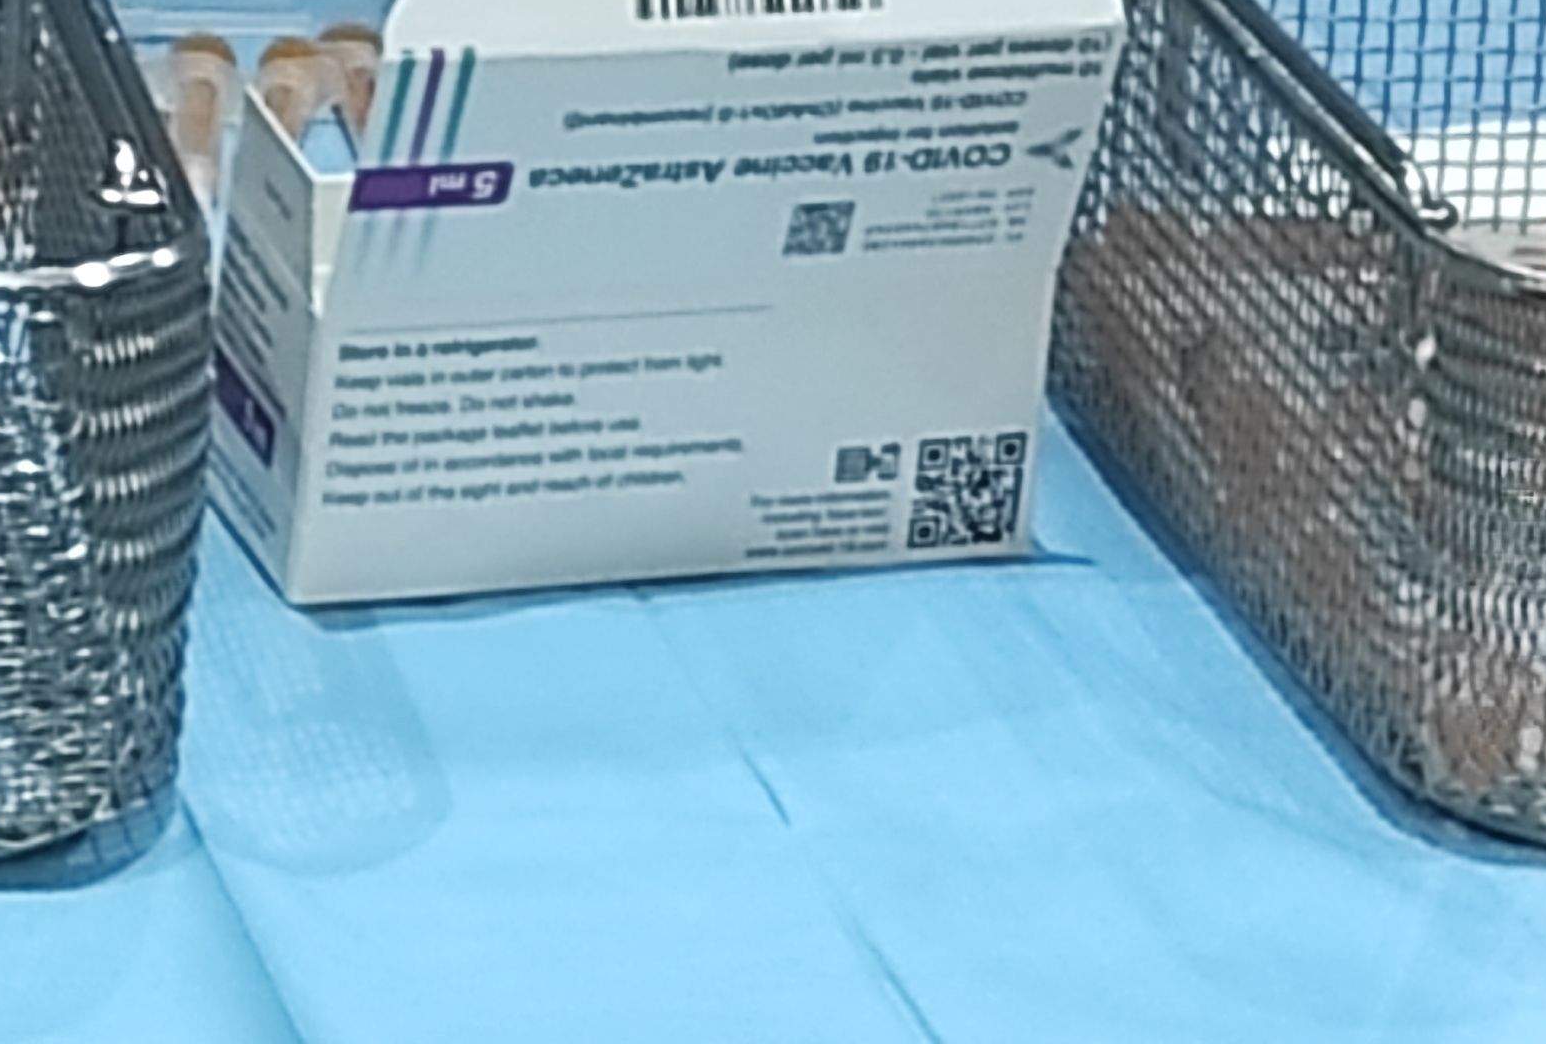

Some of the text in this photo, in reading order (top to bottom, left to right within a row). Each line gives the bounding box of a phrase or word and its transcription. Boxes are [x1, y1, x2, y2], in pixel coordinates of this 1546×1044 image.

[847, 97, 925, 113] Vaccine
[930, 91, 1028, 110] COVID-19
[529, 142, 1012, 189] COVID-19 Vaccine AstraZeneca
[427, 170, 498, 199] 5 ml
[338, 344, 388, 362] Store
[394, 343, 411, 358] in
[415, 343, 428, 358] a
[334, 375, 381, 392] Keep
[387, 372, 426, 387] vials
[430, 371, 445, 385] in
[450, 368, 494, 384] outer
[500, 365, 554, 382] carton
[558, 363, 575, 378] to
[580, 358, 640, 379] protect
[644, 357, 682, 372] from
[332, 402, 358, 421] Do
[363, 402, 390, 418] not
[459, 394, 485, 414] Do
[490, 395, 517, 411] not
[329, 431, 376, 448] Read
[382, 431, 409, 446] the
[414, 427, 487, 446] package
[493, 421, 543, 440] leaflet
[549, 419, 604, 436] before
[325, 461, 396, 479] Dispose
[401, 458, 419, 474] of
[424, 457, 439, 472] in
[444, 452, 542, 472] accordance
[549, 448, 582, 464] with
[587, 445, 627, 462] local
[322, 491, 369, 507] Keep
[374, 489, 401, 504] out
[405, 485, 423, 502] of
[427, 485, 455, 501] the
[460, 482, 501, 502] sight
[506, 479, 539, 497] and
[542, 475, 591, 493] reach
[595, 473, 614, 490] of
